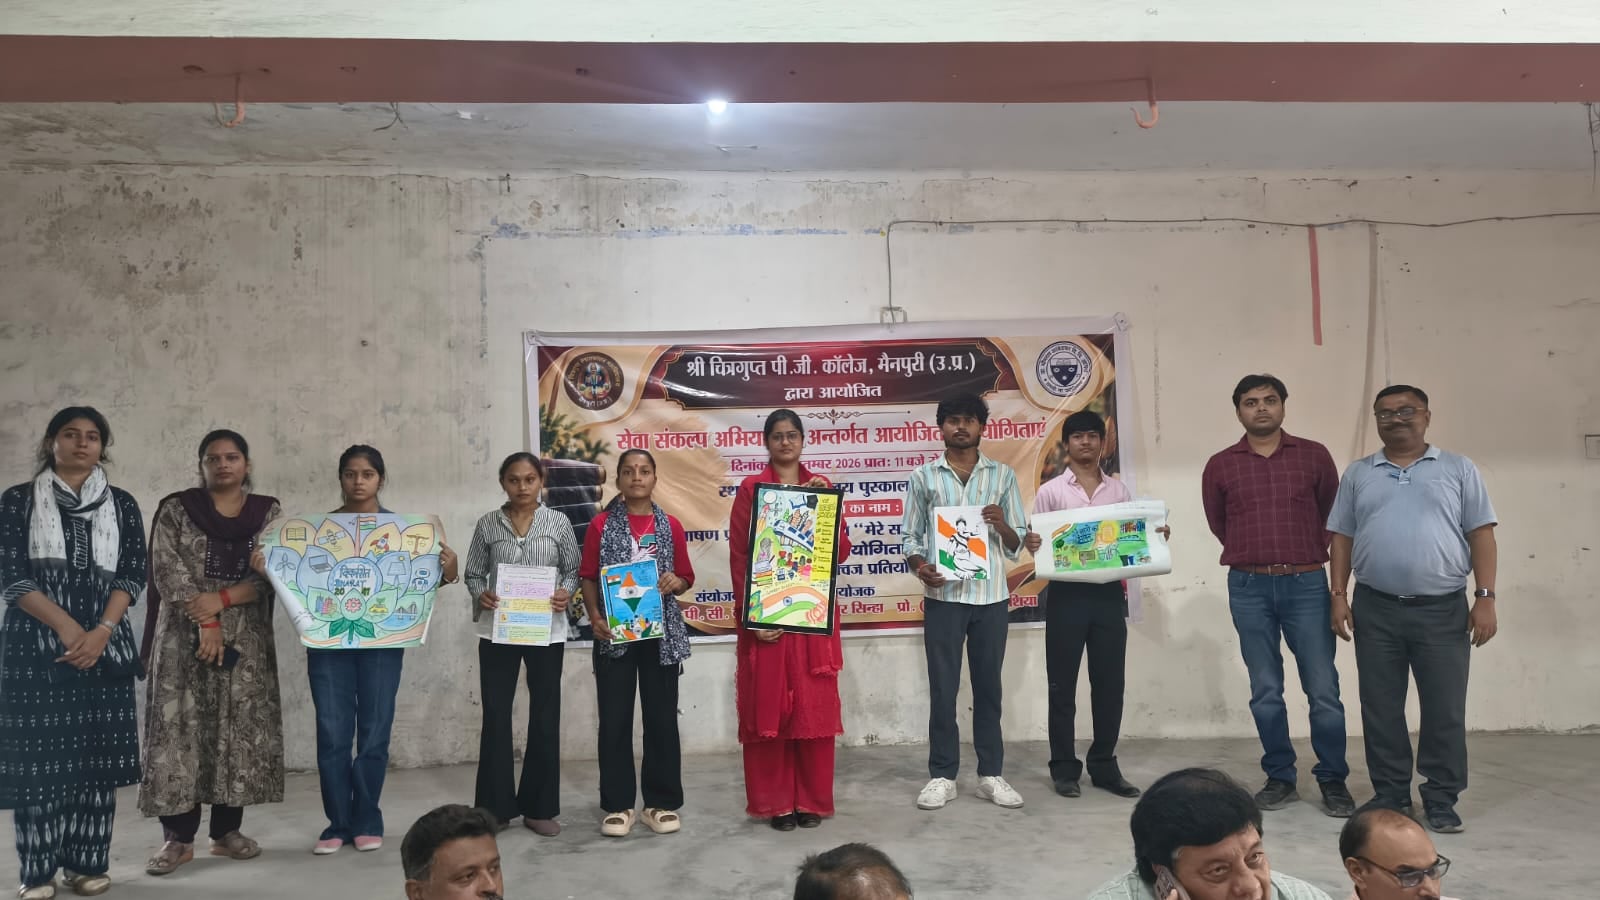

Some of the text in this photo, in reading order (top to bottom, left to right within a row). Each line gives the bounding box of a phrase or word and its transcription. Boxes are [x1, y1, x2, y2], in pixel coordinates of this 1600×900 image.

[686, 356, 705, 377] श्री
[710, 355, 767, 381] चित्रगुप्त
[822, 353, 873, 375] कॉलेज,
[877, 351, 925, 378] मैनपुरी
[784, 382, 882, 401] द्वारा आयोजित
[616, 428, 649, 449] सेवा
[655, 427, 708, 449] संकल्प
[808, 422, 868, 445] अन्तर्गत
[836, 458, 861, 469] 2026
[896, 456, 904, 467] 11
[907, 454, 925, 467] बजे
[859, 481, 910, 497] पुस्काल
[850, 504, 865, 514] का
[868, 502, 891, 513] नाम
[334, 588, 345, 596] 20
[695, 589, 736, 603] संयोज
[851, 600, 884, 614] सिन्हा
